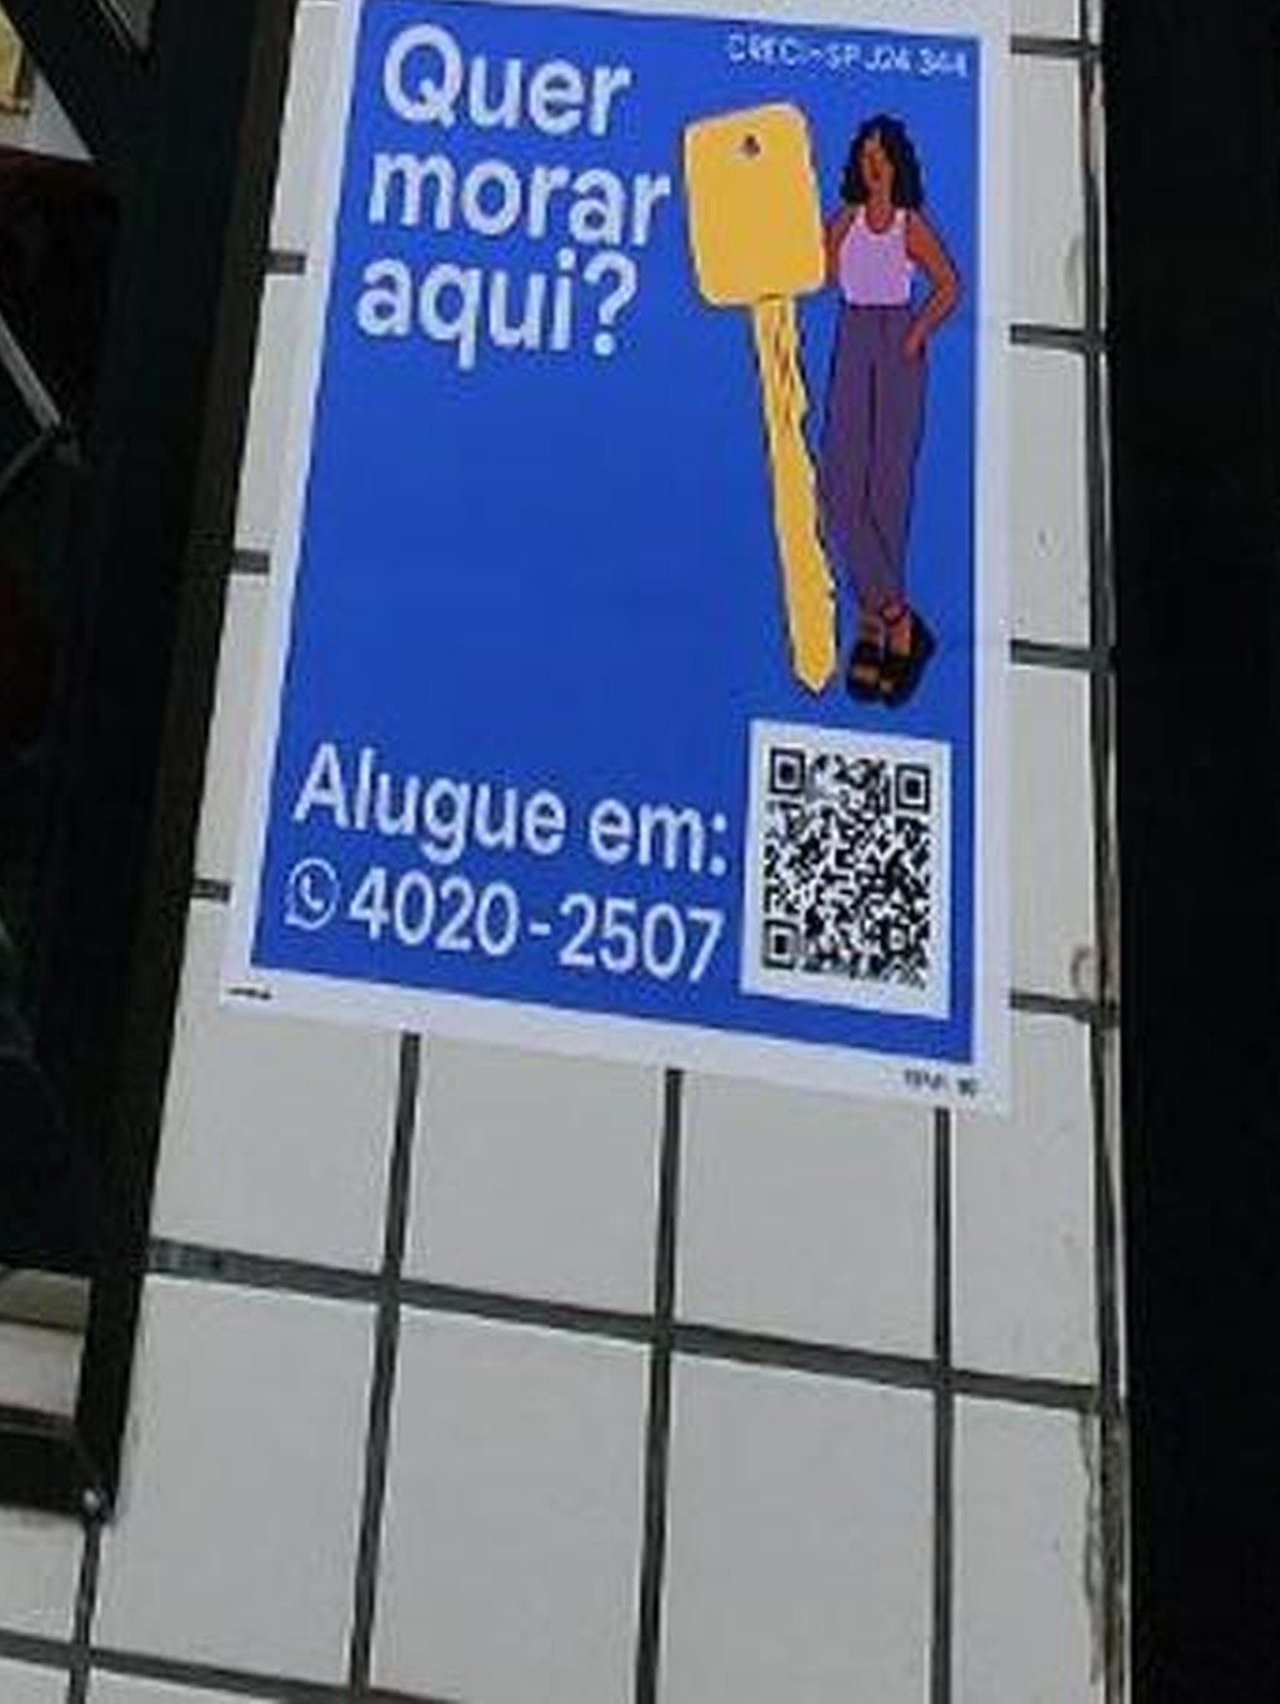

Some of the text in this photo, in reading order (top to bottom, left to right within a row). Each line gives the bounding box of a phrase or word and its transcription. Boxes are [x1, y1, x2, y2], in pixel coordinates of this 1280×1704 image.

[381, 23, 633, 138] Quer
[369, 150, 671, 247] morar
[357, 248, 638, 370] aqui?
[292, 742, 729, 878] Alugue em:
[348, 866, 727, 984] 4020-2507
